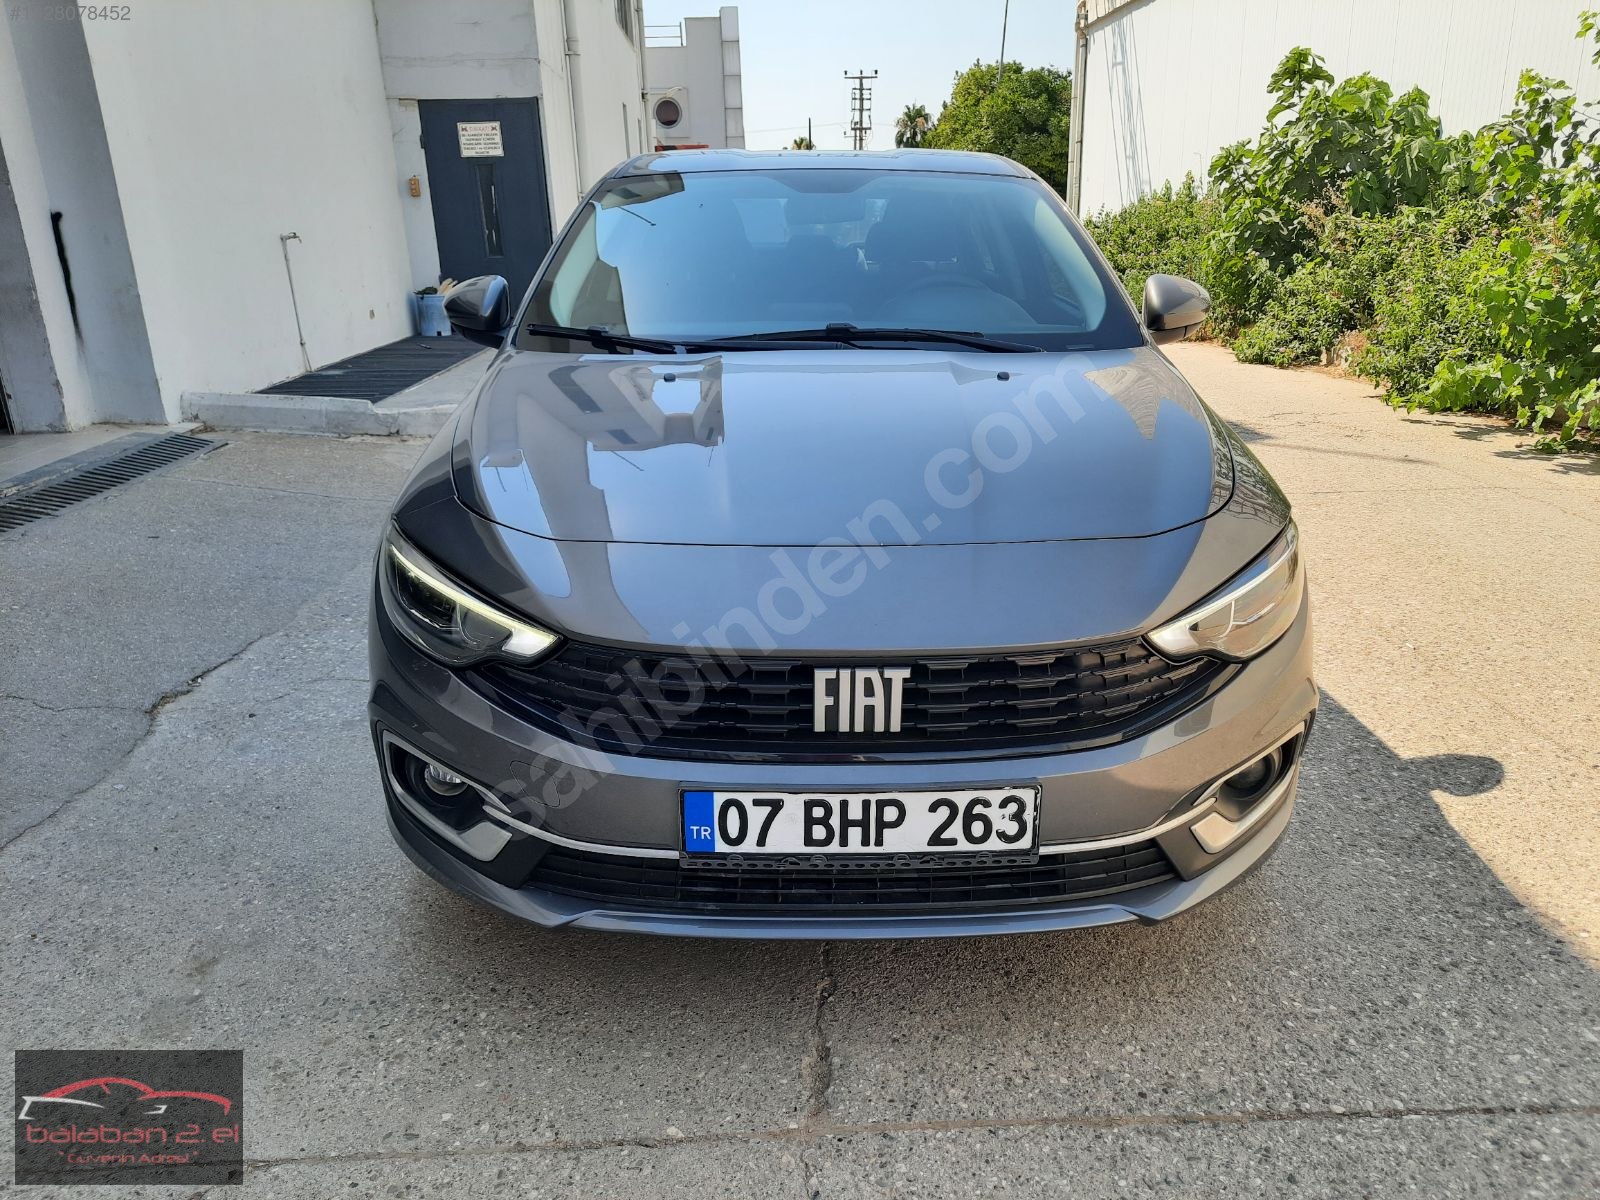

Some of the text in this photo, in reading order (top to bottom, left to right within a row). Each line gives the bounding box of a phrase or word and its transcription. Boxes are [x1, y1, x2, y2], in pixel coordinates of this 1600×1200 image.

[814, 667, 911, 733] FIAT
[690, 825, 711, 841] TR
[717, 795, 1028, 848] 07 BHP 263
